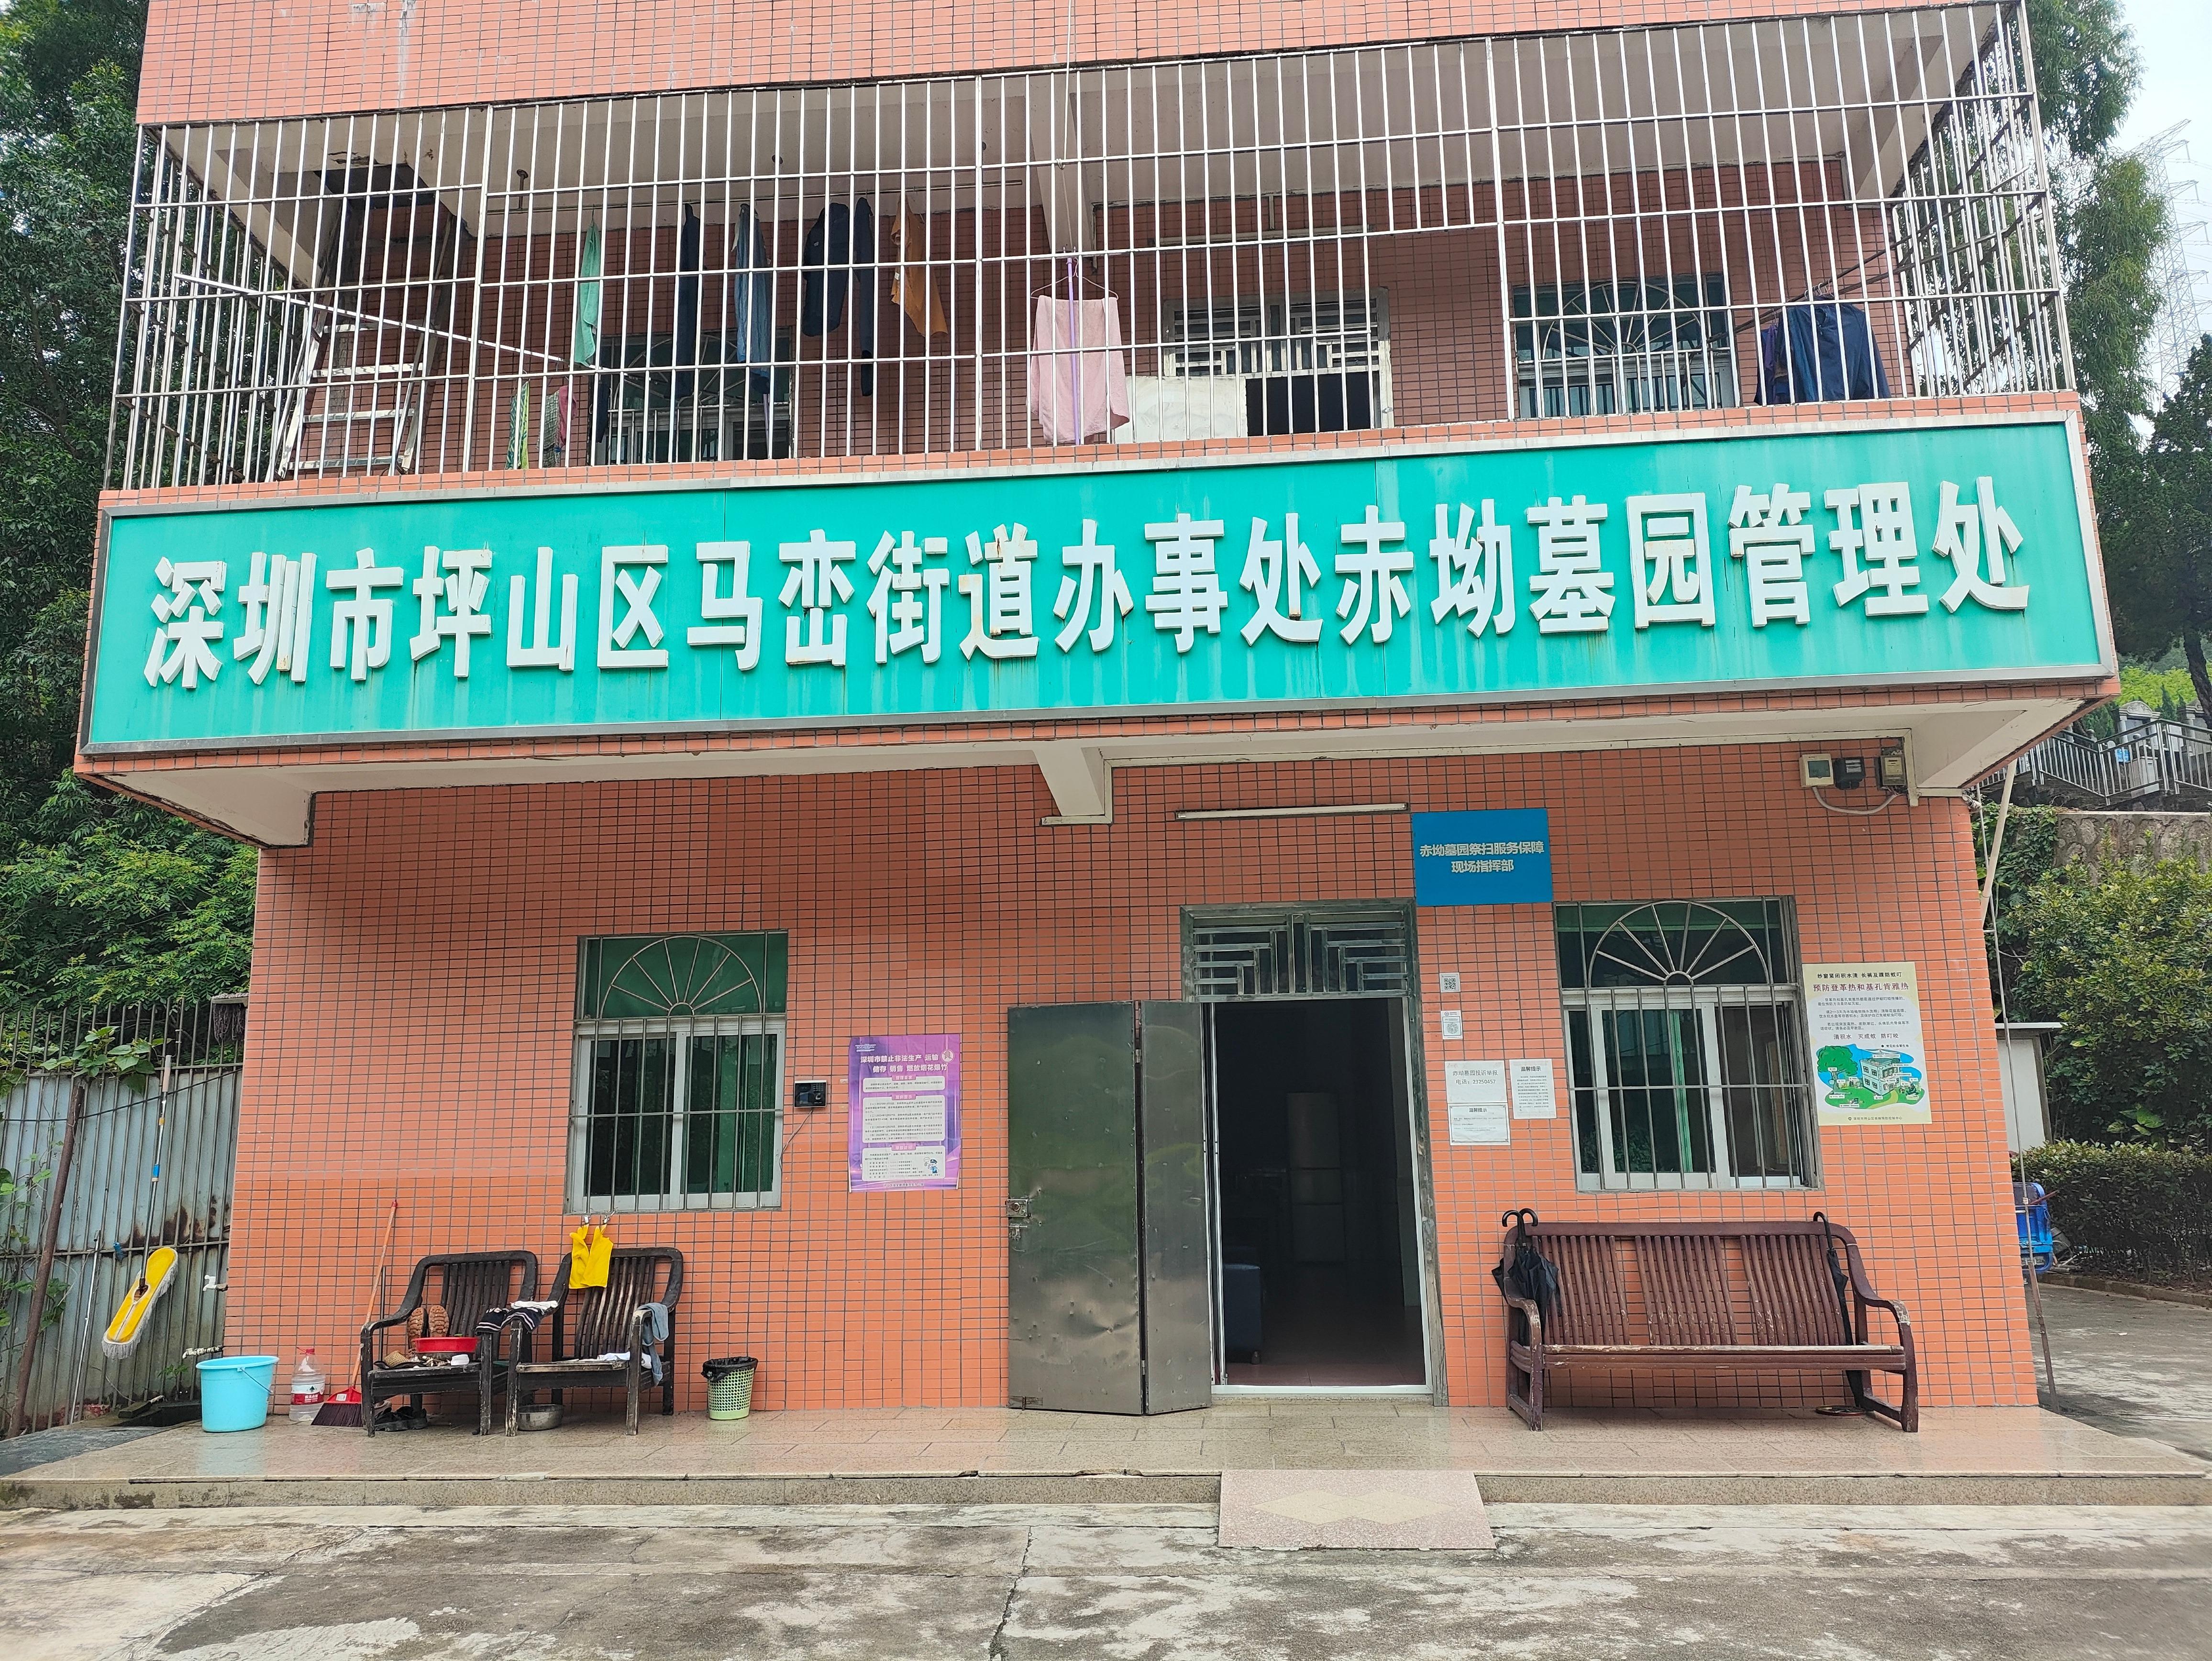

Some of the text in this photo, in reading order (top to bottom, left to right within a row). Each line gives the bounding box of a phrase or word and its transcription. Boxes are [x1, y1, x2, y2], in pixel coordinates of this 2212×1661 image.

[143, 476, 2030, 689] 深圳市坪山区马峦街道办事处赤坳墓园管理处
[1419, 841, 1545, 857] 赤坳墓园祭扫服务保障
[1451, 859, 1514, 873] 现场指挥部
[1813, 982, 1909, 992] 预防登革热和基孔肯雅热
[860, 1054, 922, 1063] 深圳市禁止非法生产
[907, 1063, 948, 1072] 燃放烟花爆竹
